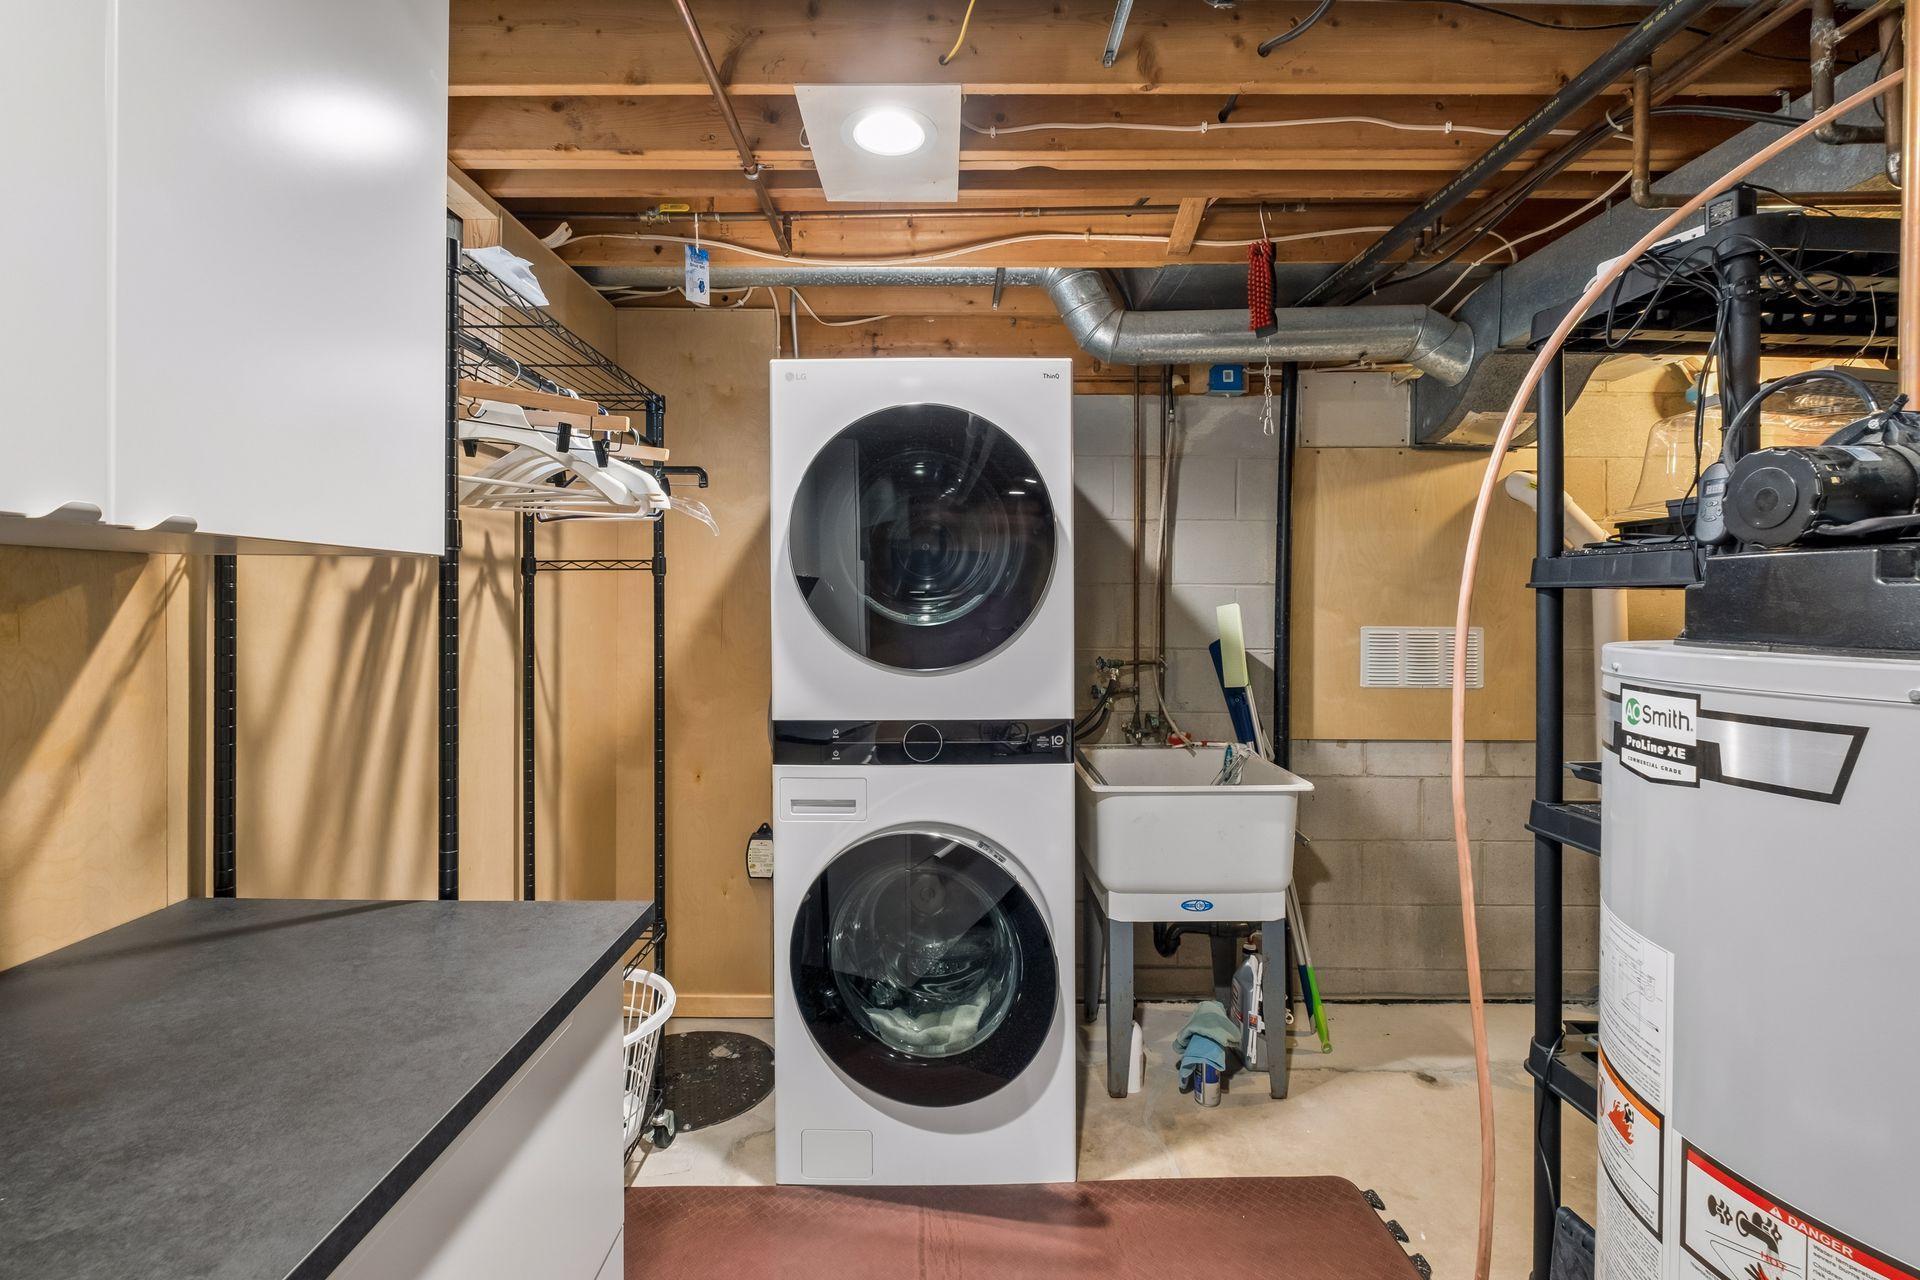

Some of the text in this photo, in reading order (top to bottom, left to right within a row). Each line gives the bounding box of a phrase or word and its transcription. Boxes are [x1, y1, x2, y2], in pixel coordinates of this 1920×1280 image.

[795, 373, 807, 381] LG
[1642, 705, 1690, 731] Smith
[1667, 745, 1686, 760] XE
[1627, 755, 1682, 775] COMMERCIAL GRADE
[1788, 1217, 1855, 1259] DANGER
